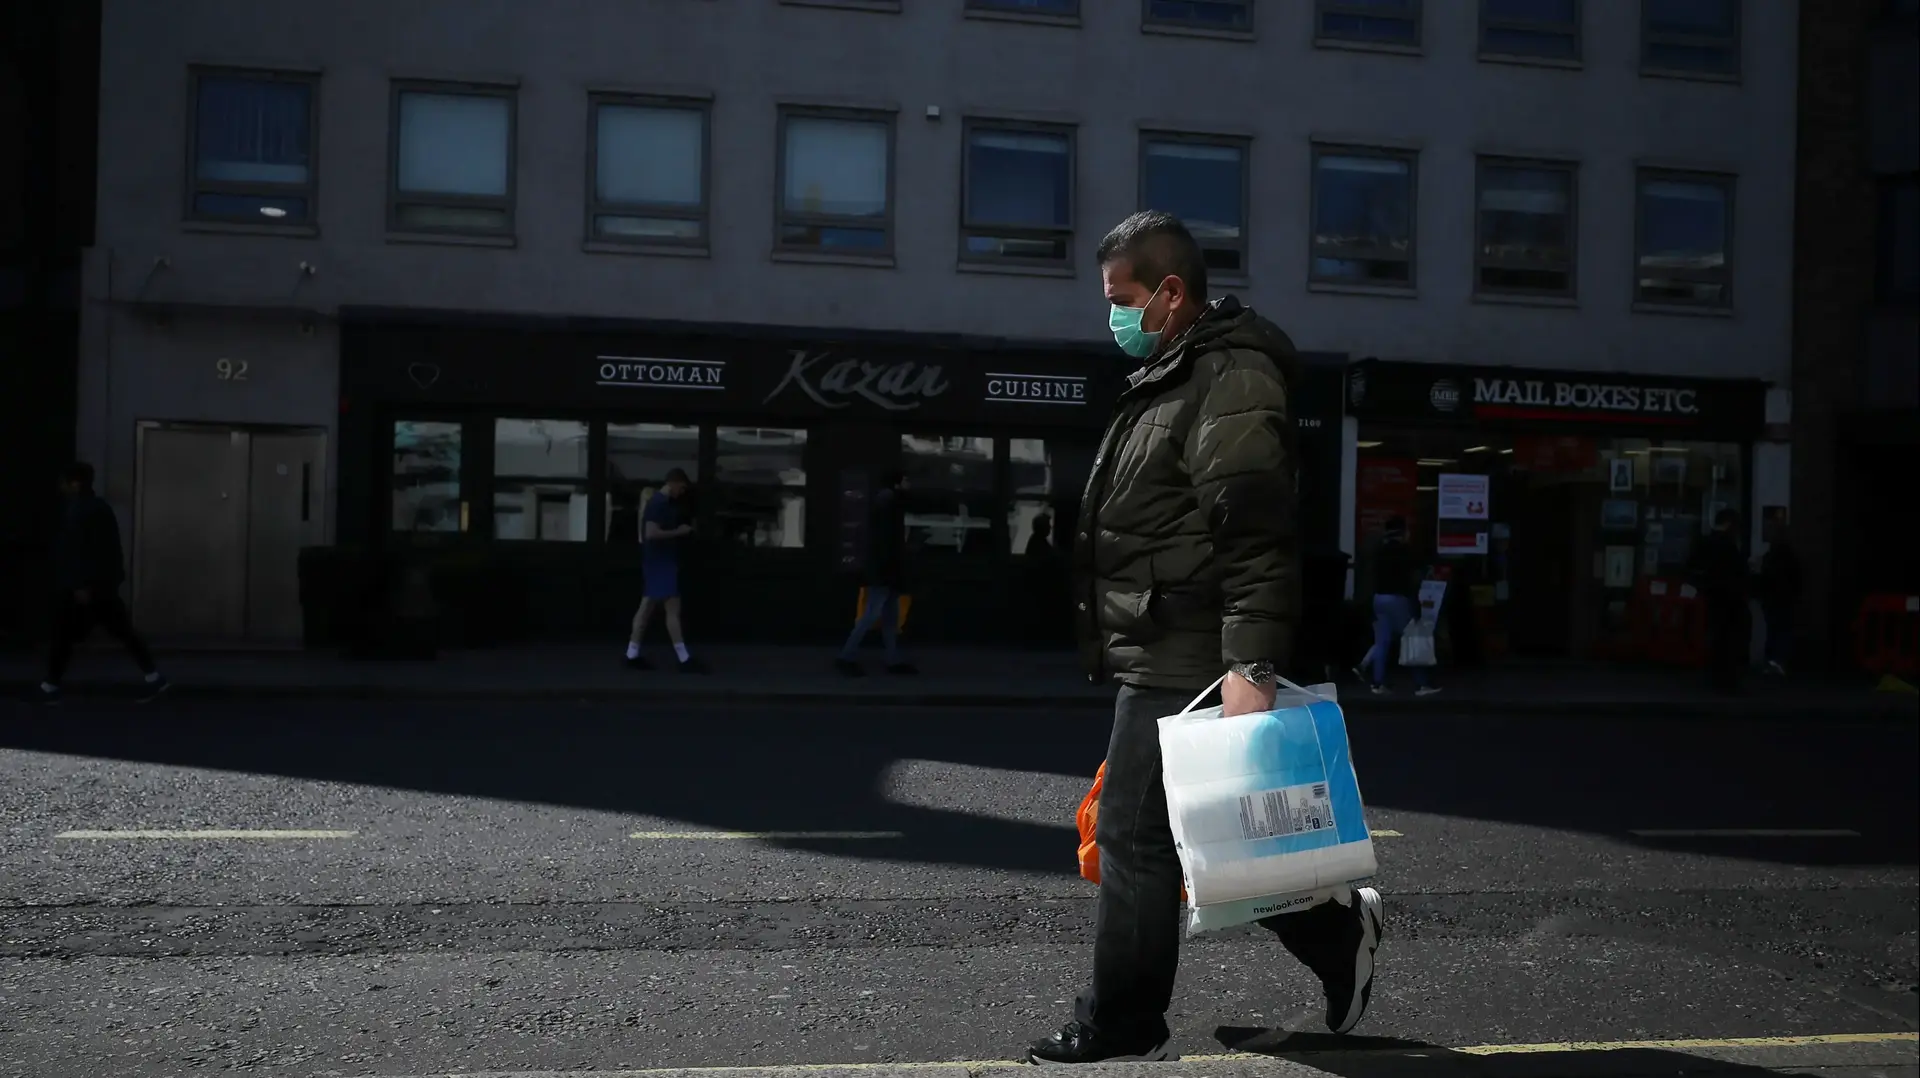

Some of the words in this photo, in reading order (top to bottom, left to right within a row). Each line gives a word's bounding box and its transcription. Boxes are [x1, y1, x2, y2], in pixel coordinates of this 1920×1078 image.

[216, 358, 249, 381] 92
[600, 363, 722, 384] OTTOMAN
[762, 349, 950, 411] Kazan
[988, 380, 1084, 399] CUISINE
[1473, 378, 1550, 406] MAIL
[1554, 382, 1640, 410] BOXES
[1643, 388, 1700, 414] ETC.
[1253, 895, 1314, 914] newlook.com
